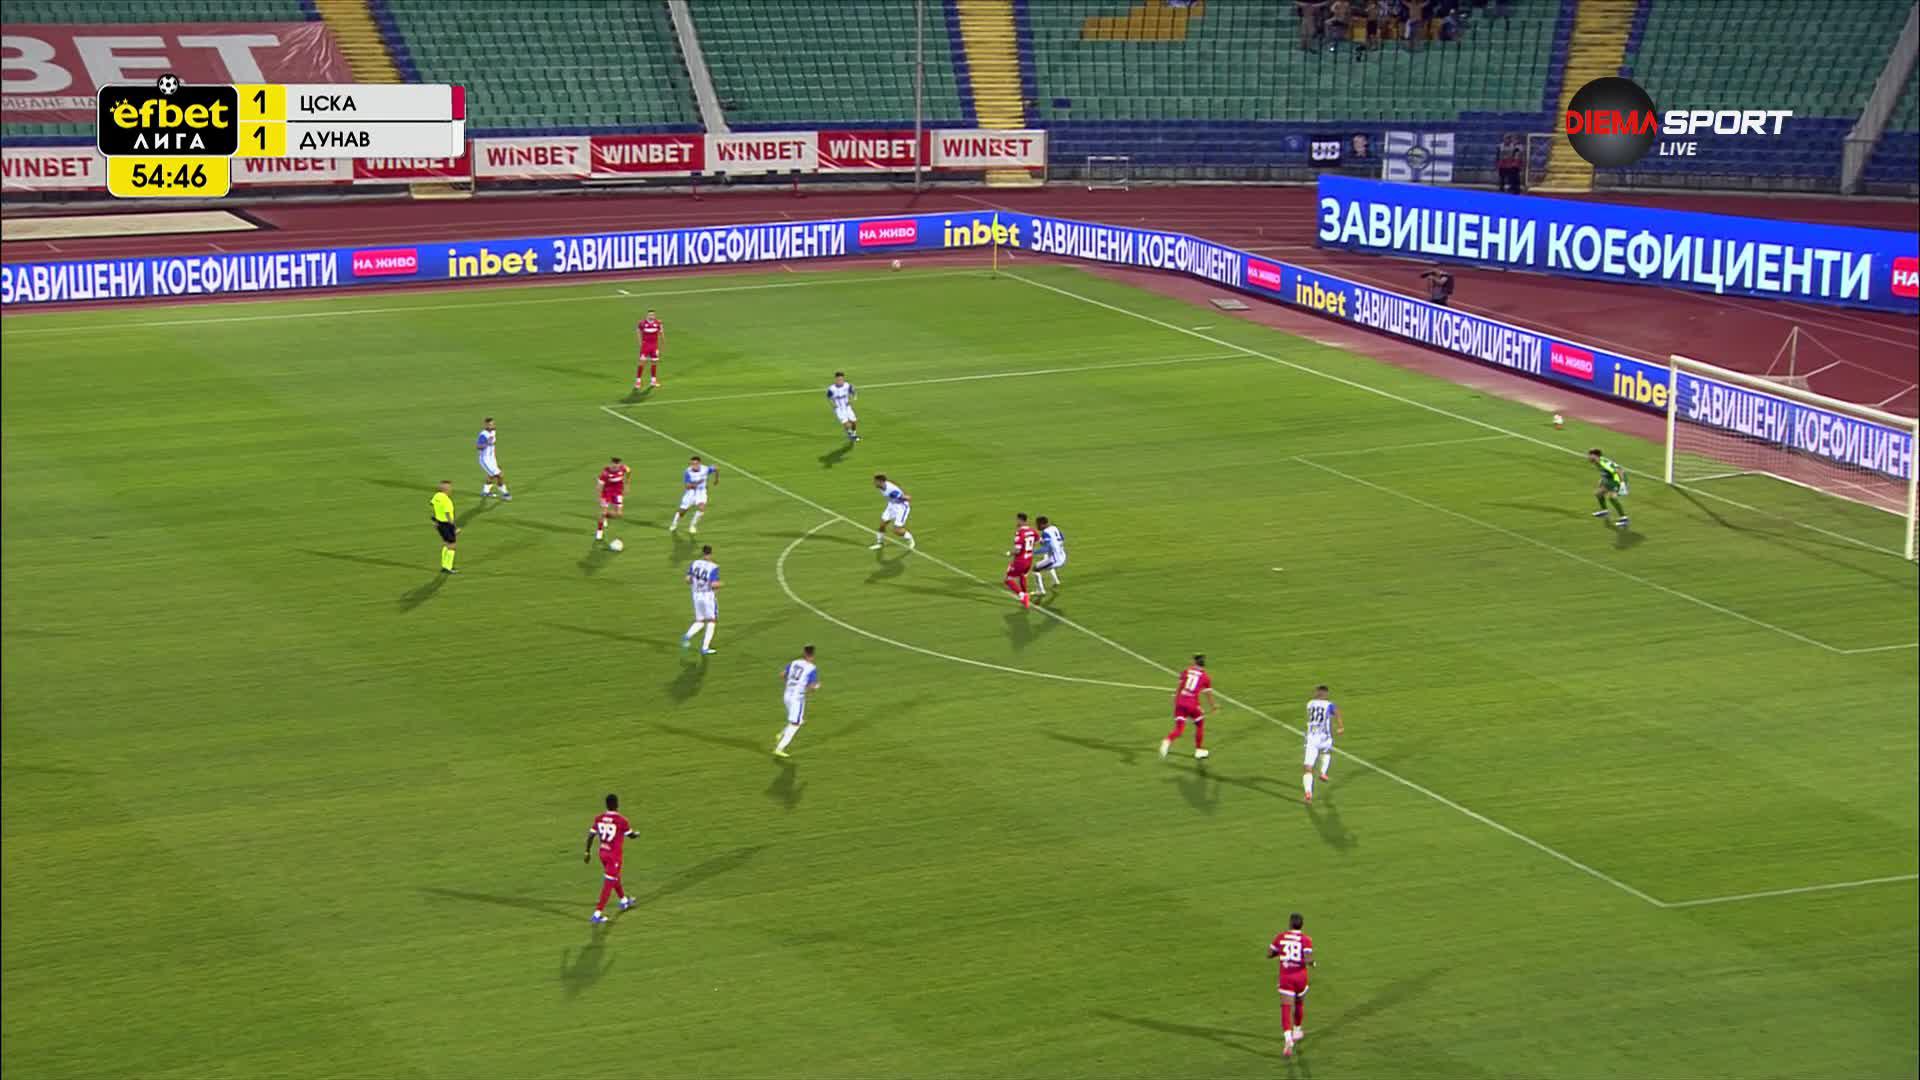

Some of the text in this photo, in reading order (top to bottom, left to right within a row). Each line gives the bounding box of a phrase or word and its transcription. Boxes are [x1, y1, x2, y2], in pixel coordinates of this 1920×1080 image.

[487, 146, 579, 168] WINBET
[601, 143, 693, 165] WINBET
[717, 140, 807, 162] WINBET
[829, 138, 918, 160] WINBET
[943, 137, 1033, 158] WINBET
[244, 157, 338, 172] WINBET
[859, 227, 916, 240] НА ЖИВО
[944, 219, 1020, 248] inbet
[553, 223, 846, 273] ЗАВИШЕНИ КОЕФИЦИЕНТИ
[1031, 219, 1241, 286] ЗАВИШЕНИ КОЕФИЦИЕНТИ
[1319, 197, 1872, 301] ЗАВИШЕНИ КОЕФИЦИЕНТИ
[354, 255, 416, 269] НА ЖИВО
[448, 248, 538, 277] inbet
[1, 253, 338, 303] ЗАВИШЕНИ КОЕФИЦИЕНТИ
[1892, 269, 1918, 288] НА
[1296, 274, 1347, 317] inbet
[1353, 288, 1543, 375] ЗАВИШЕНИ КОЕФИЦИЕНТИ
[1551, 352, 1564, 365] НА
[1688, 380, 1914, 481] ЗАВИШЕНИ КОЕФИЦИЕН
[597, 821, 617, 842] 99
[1279, 939, 1302, 961] 38
